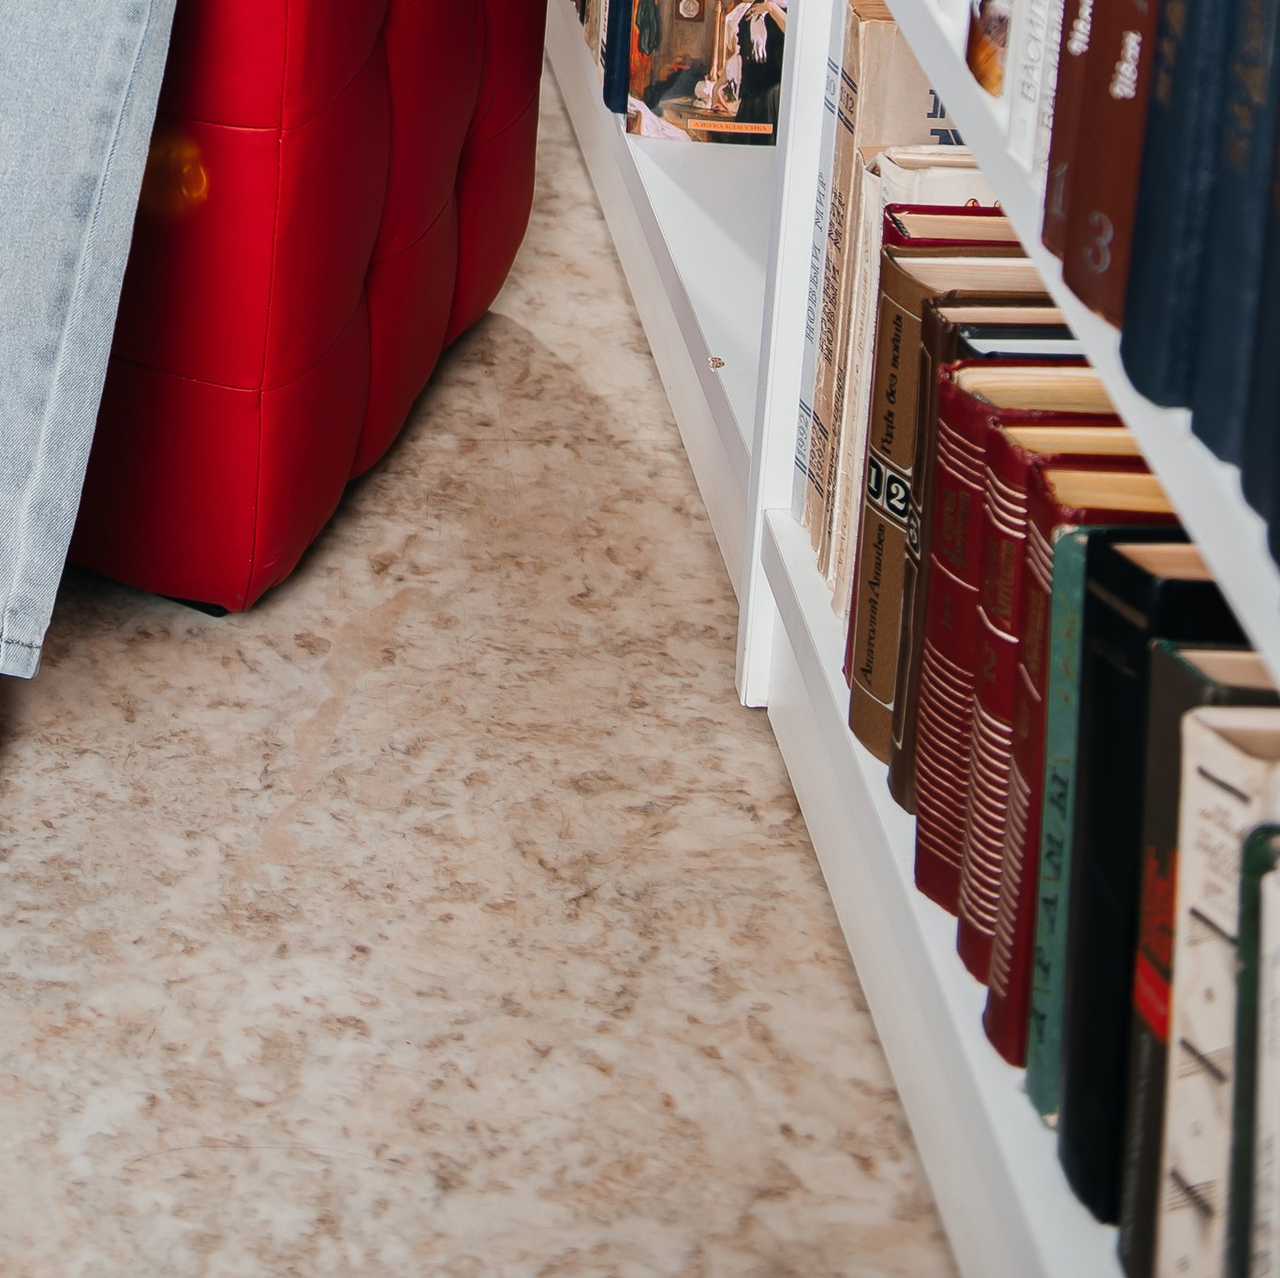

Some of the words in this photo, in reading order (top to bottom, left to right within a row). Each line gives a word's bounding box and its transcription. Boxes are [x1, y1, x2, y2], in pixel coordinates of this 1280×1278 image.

[1108, 30, 1143, 100] Иван
[693, 121, 724, 131] АЗБУКА
[724, 123, 768, 133] КЛАССИКА
[803, 242, 821, 344] НОВЫЙ
[814, 170, 828, 231] МИР
[886, 313, 903, 370] войны
[883, 375, 898, 404] без
[879, 410, 896, 456] Годы
[890, 482, 905, 506] 2
[866, 523, 887, 594] Ананьев
[859, 599, 881, 686] Анатолий
